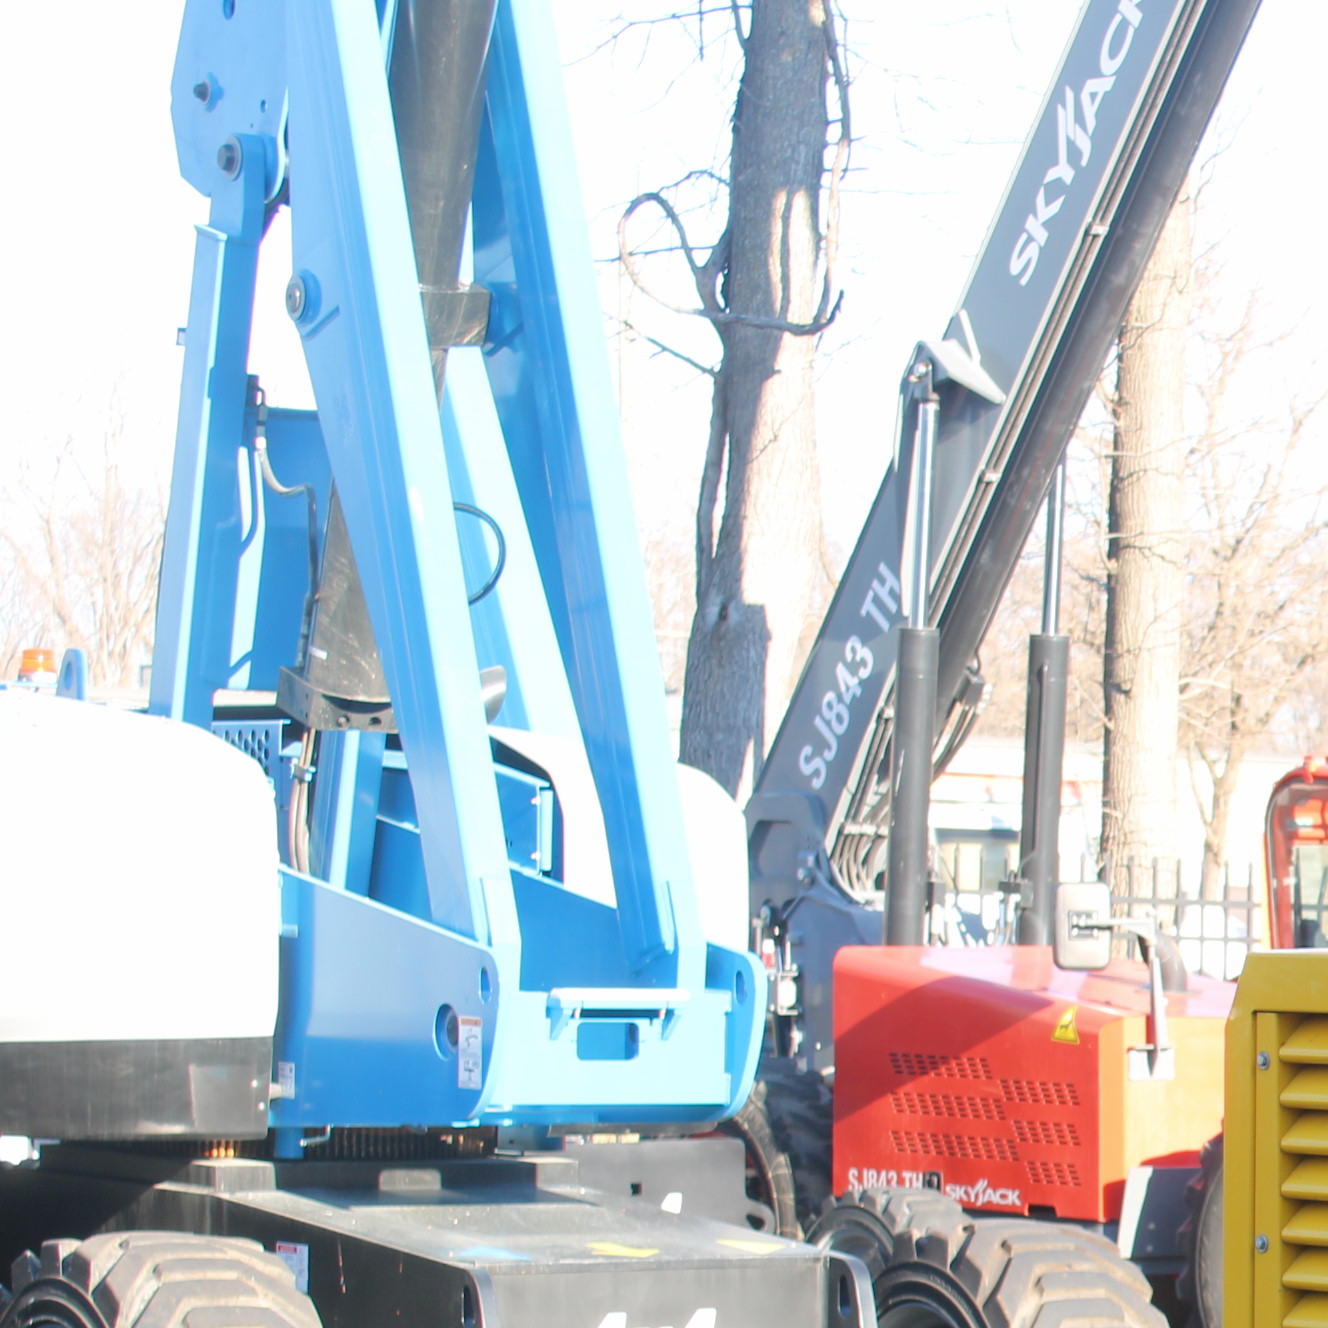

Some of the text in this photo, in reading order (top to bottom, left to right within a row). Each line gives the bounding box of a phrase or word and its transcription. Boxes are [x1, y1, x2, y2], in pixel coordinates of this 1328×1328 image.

[799, 562, 900, 789] SJ843 TH
[945, 1179, 1022, 1207] SKYJACK
